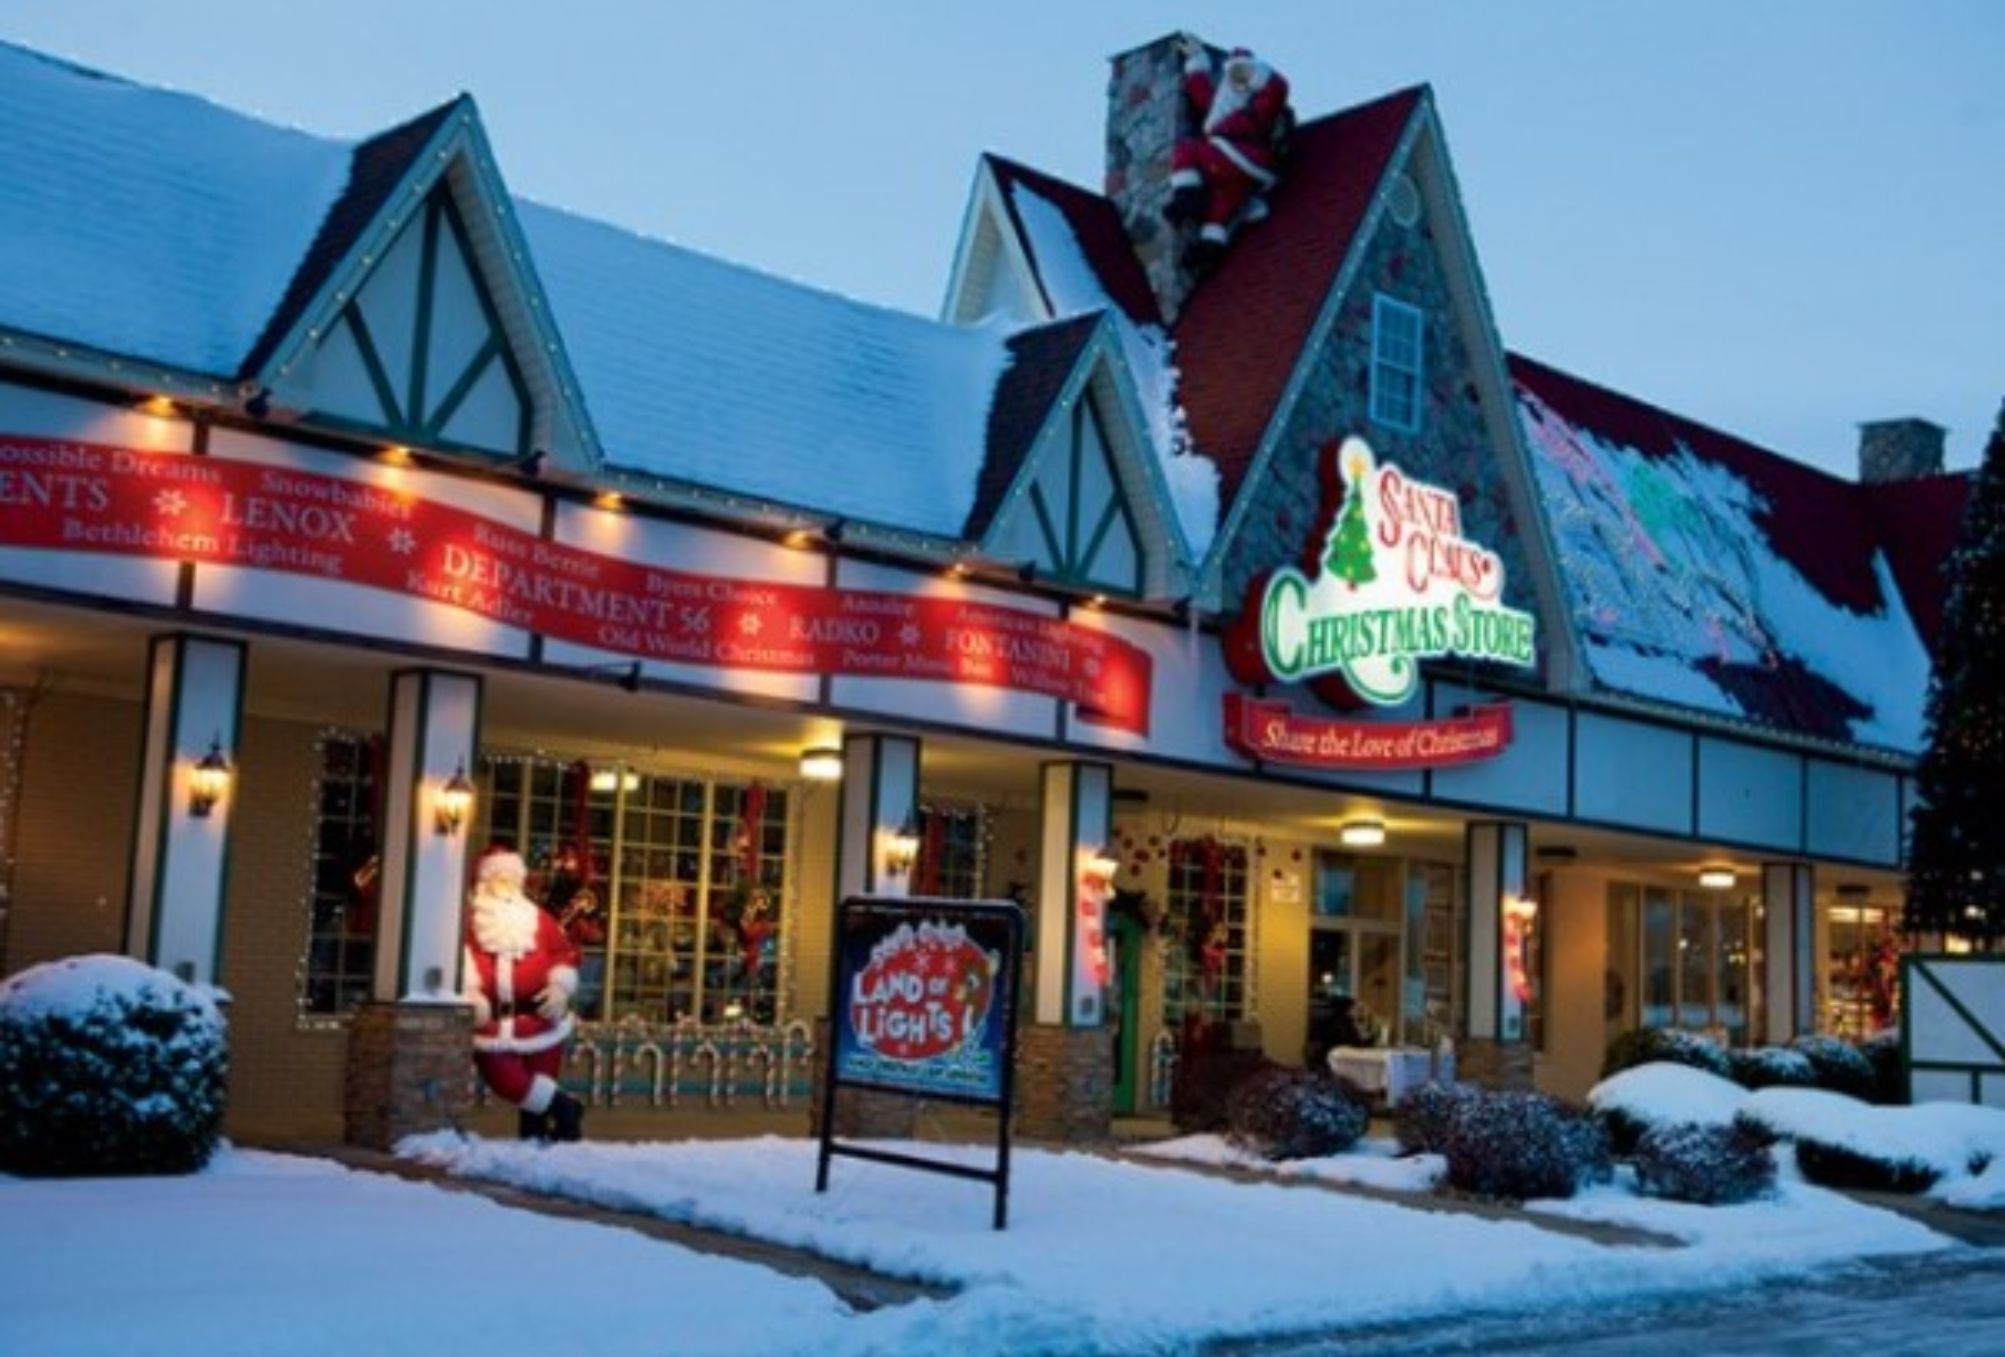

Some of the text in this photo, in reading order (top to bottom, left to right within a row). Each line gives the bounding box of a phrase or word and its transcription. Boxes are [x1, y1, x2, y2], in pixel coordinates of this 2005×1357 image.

[112, 450, 223, 483] Dreams
[221, 491, 357, 545] LENOX
[62, 516, 343, 575] Bethlehem Lighting
[443, 541, 713, 635] DEPARTMENT 56
[598, 624, 639, 648] Old
[788, 614, 880, 647] RADKO
[1319, 727, 1351, 756] the
[1354, 730, 1393, 758] Love
[1395, 728, 1417, 757] of
[852, 971, 925, 1004] LAND
